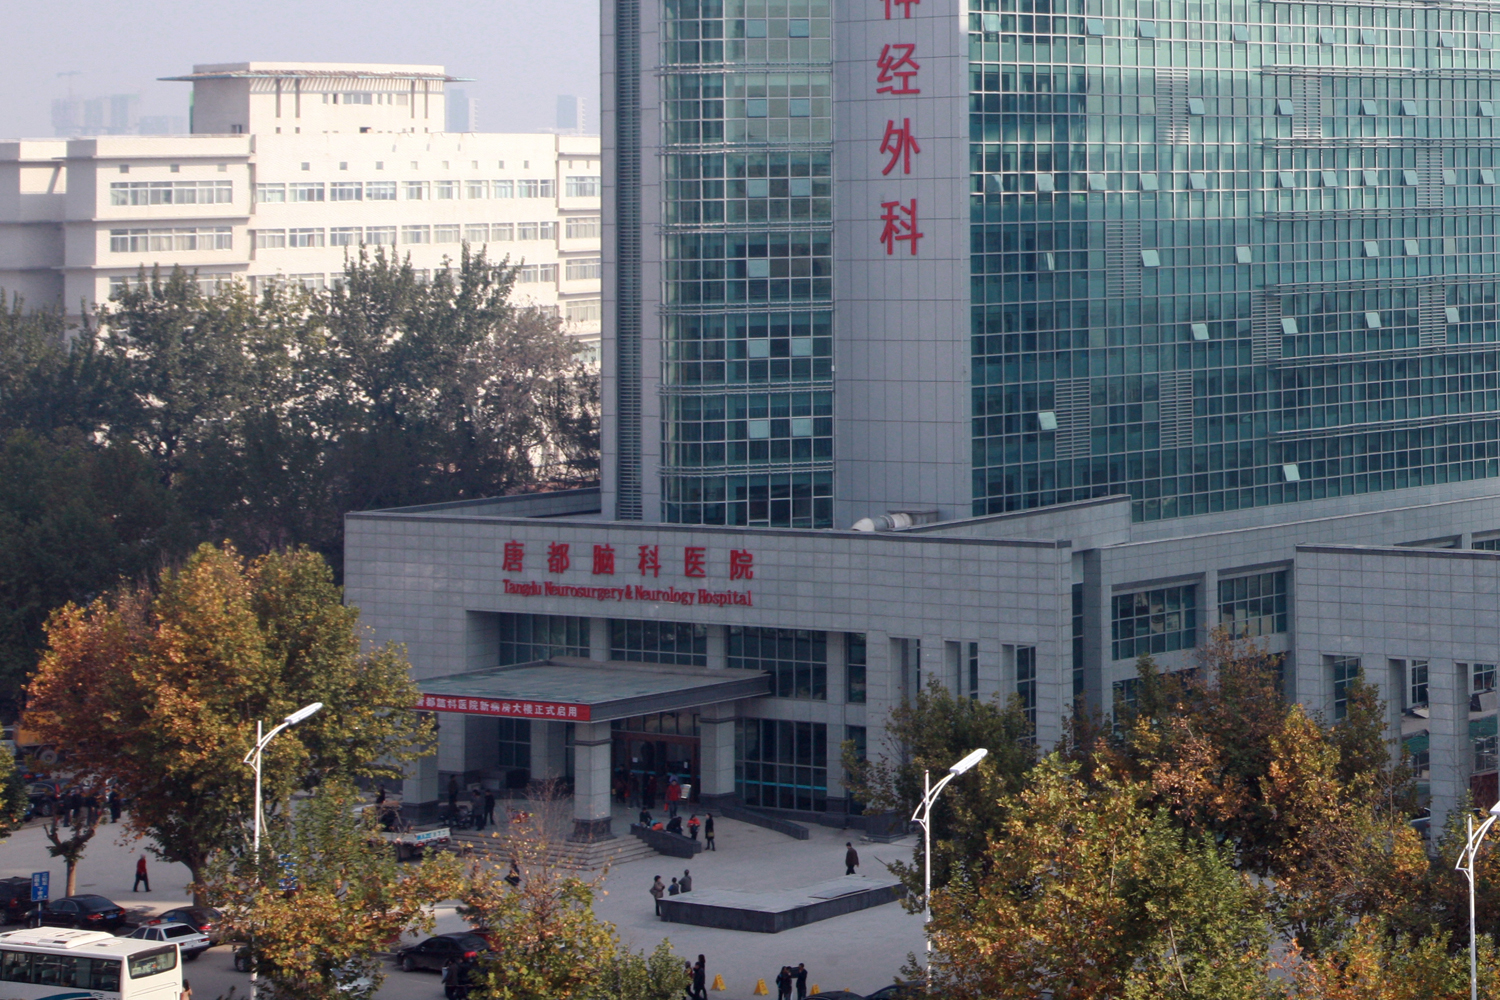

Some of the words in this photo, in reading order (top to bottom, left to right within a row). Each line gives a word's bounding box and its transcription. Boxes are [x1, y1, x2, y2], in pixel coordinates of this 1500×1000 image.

[502, 540, 754, 581] 唐都脑科医院
[503, 579, 542, 597] Tangdu
[698, 588, 753, 608] Hospital
